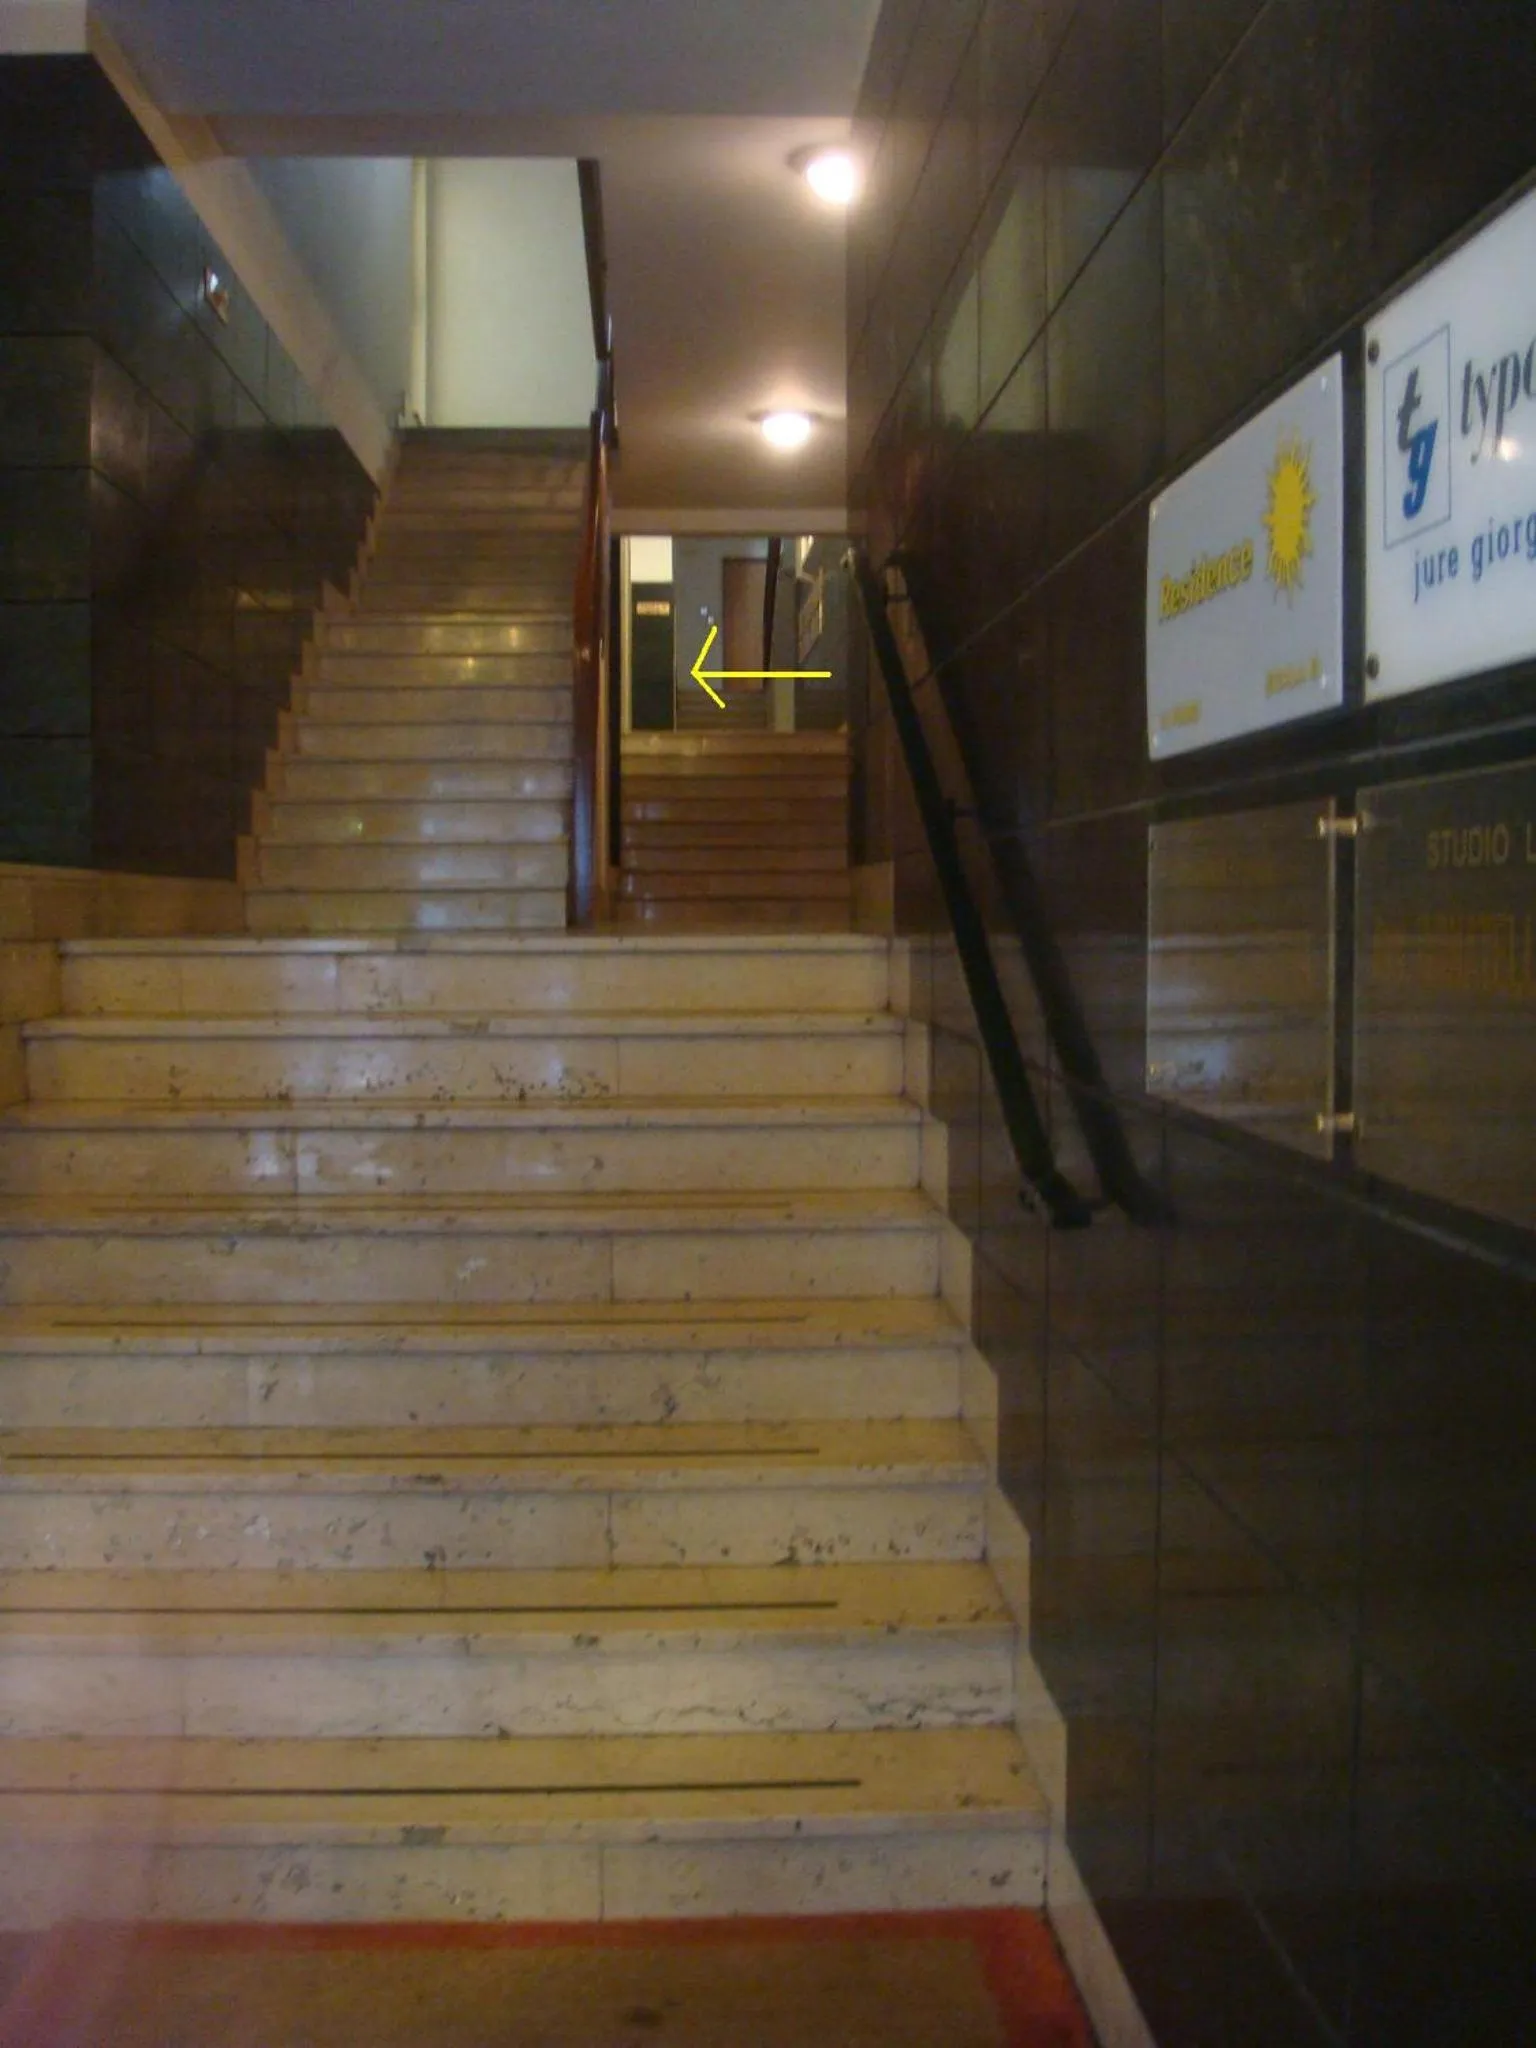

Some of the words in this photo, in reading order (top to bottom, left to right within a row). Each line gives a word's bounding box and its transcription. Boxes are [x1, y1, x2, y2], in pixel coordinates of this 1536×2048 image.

[1158, 534, 1254, 626] Residence
[1413, 545, 1458, 604] jure
[1426, 821, 1510, 871] STUDIO
